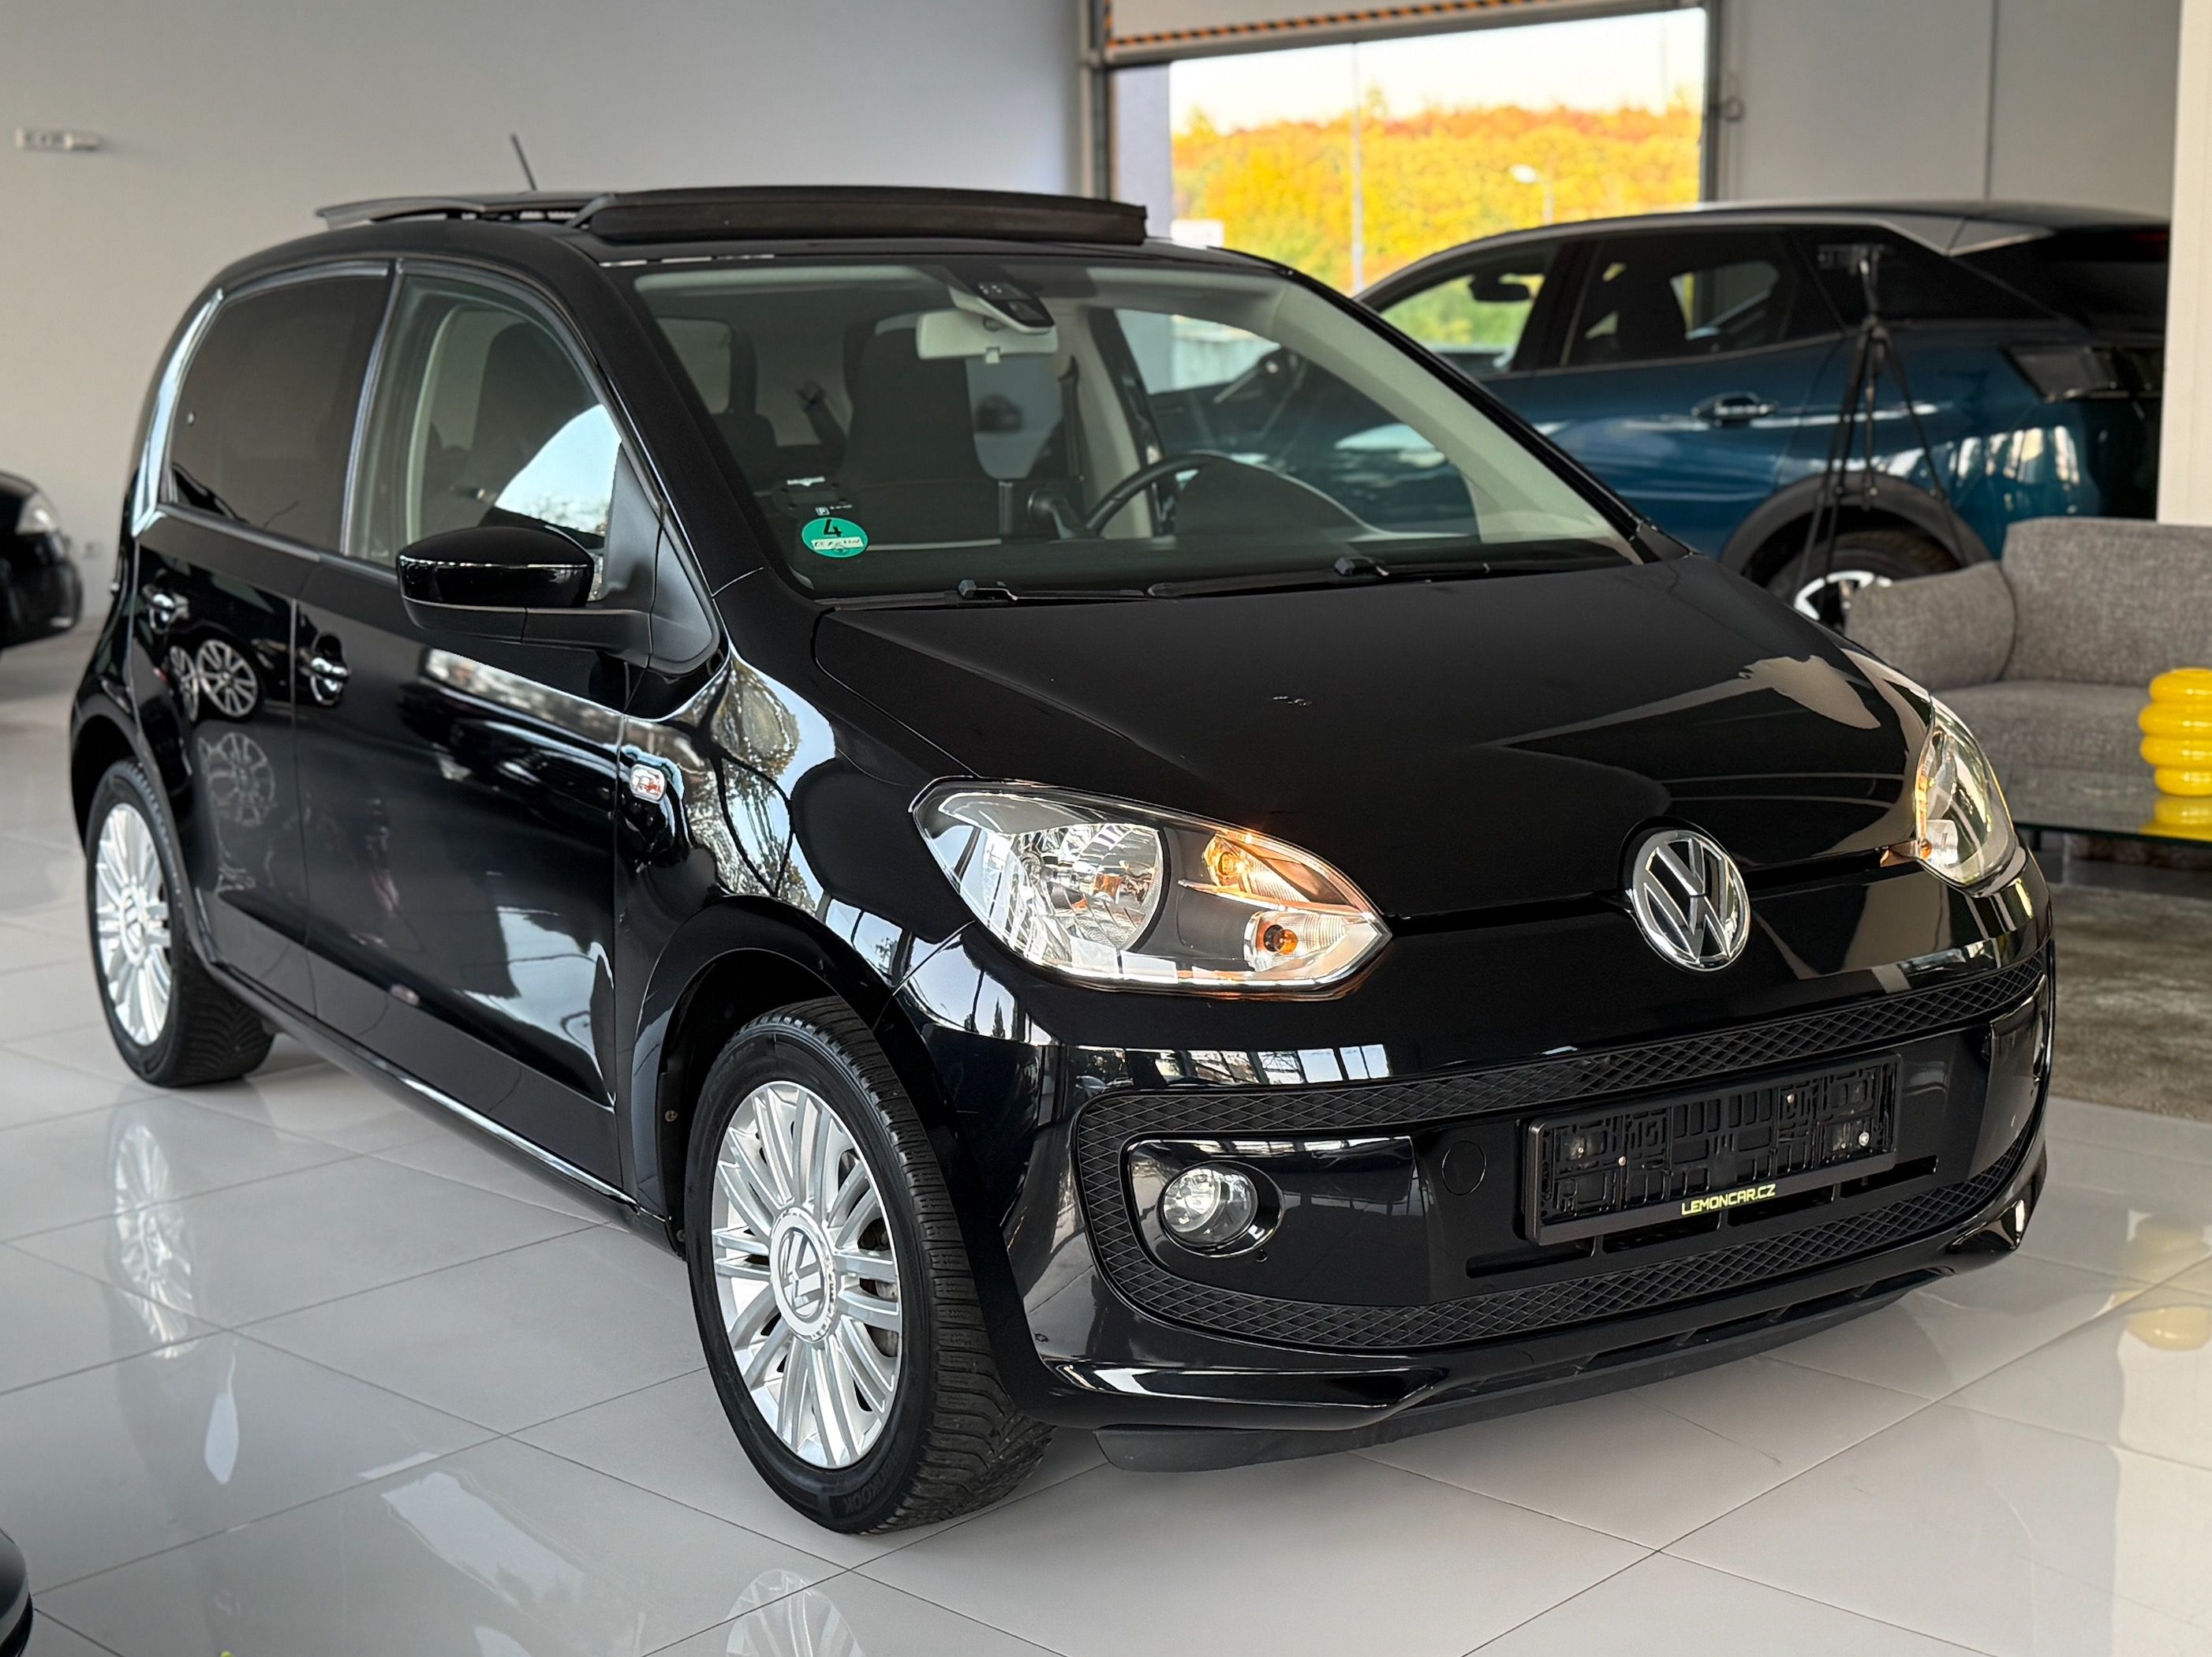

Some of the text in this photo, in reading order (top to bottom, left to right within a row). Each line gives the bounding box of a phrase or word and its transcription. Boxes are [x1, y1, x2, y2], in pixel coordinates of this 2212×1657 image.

[823, 519, 842, 537] 4
[1633, 830, 1751, 971] VW
[1681, 1184, 1777, 1215] LEMONCAR.CZ
